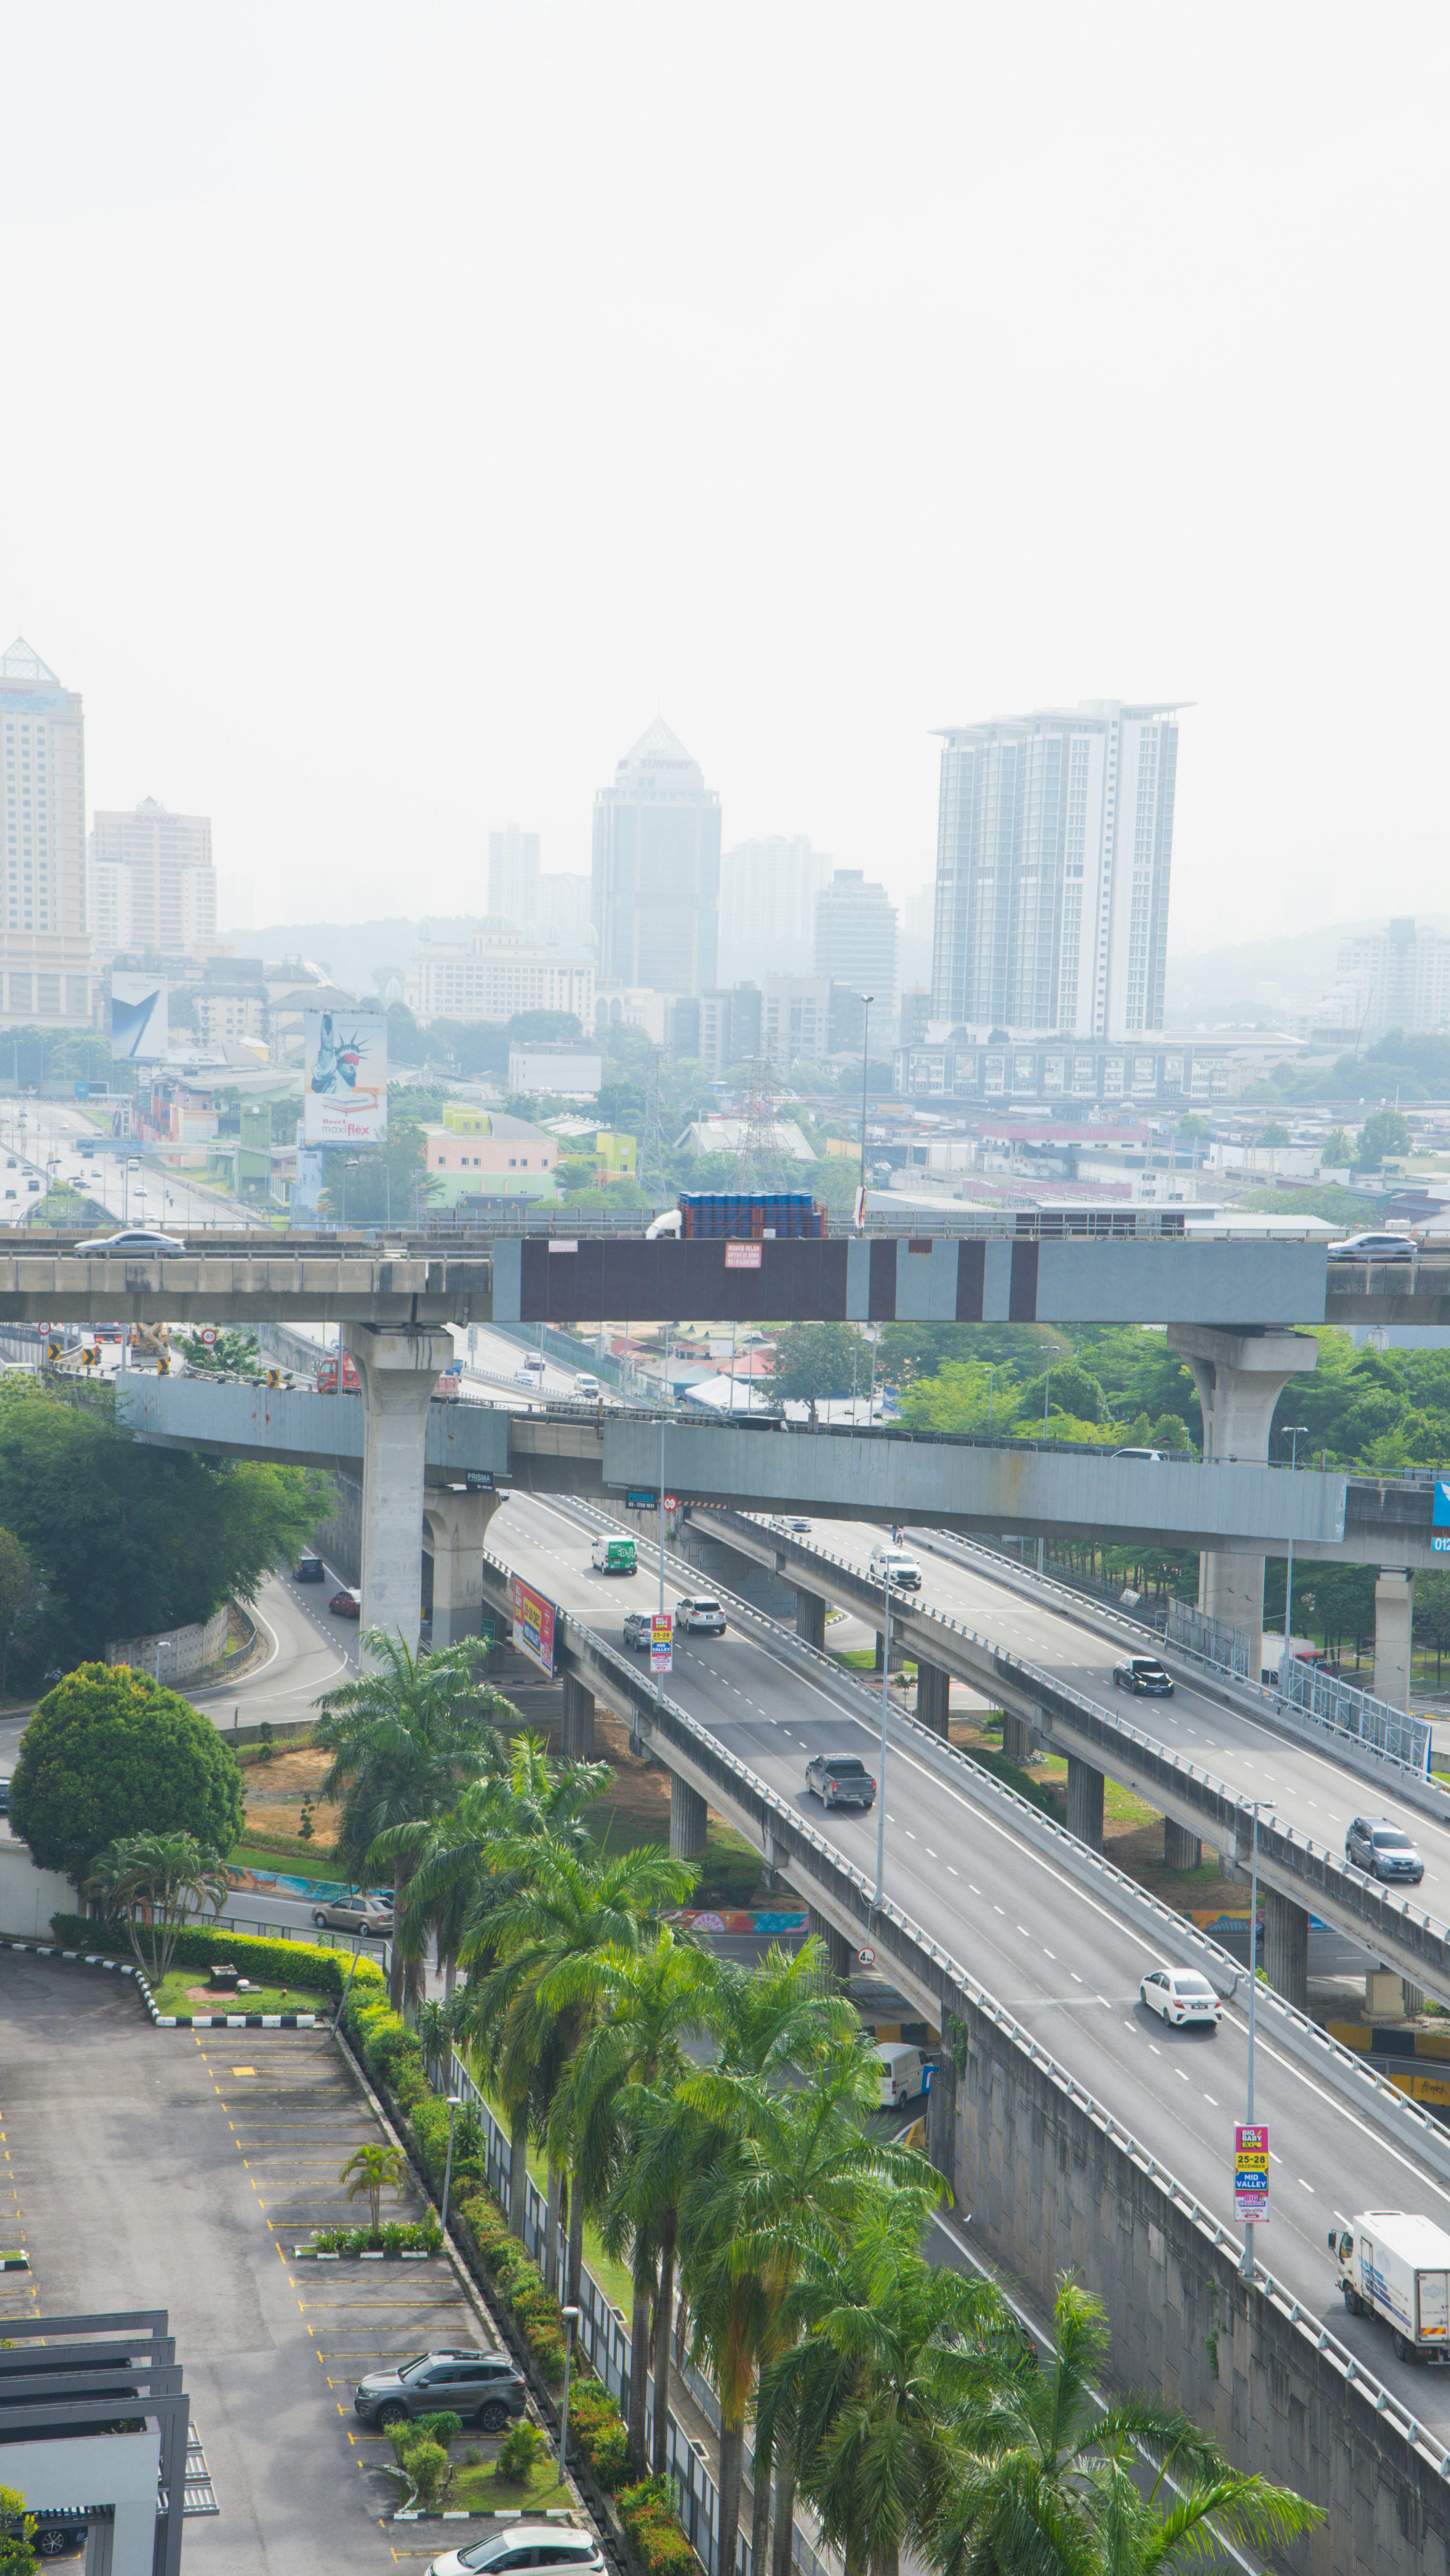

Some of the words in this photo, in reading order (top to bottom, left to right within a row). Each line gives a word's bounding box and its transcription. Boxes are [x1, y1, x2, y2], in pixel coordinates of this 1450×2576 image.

[640, 760, 691, 770] SUNWAY
[133, 815, 180, 825] SUNWAY
[322, 1124, 370, 1136] maxiflex
[467, 1473, 490, 1482] PRISMA
[628, 1493, 654, 1501] PRISMA
[529, 1629, 539, 1646] VALLEY
[1238, 2155, 1265, 2163] 25-28
